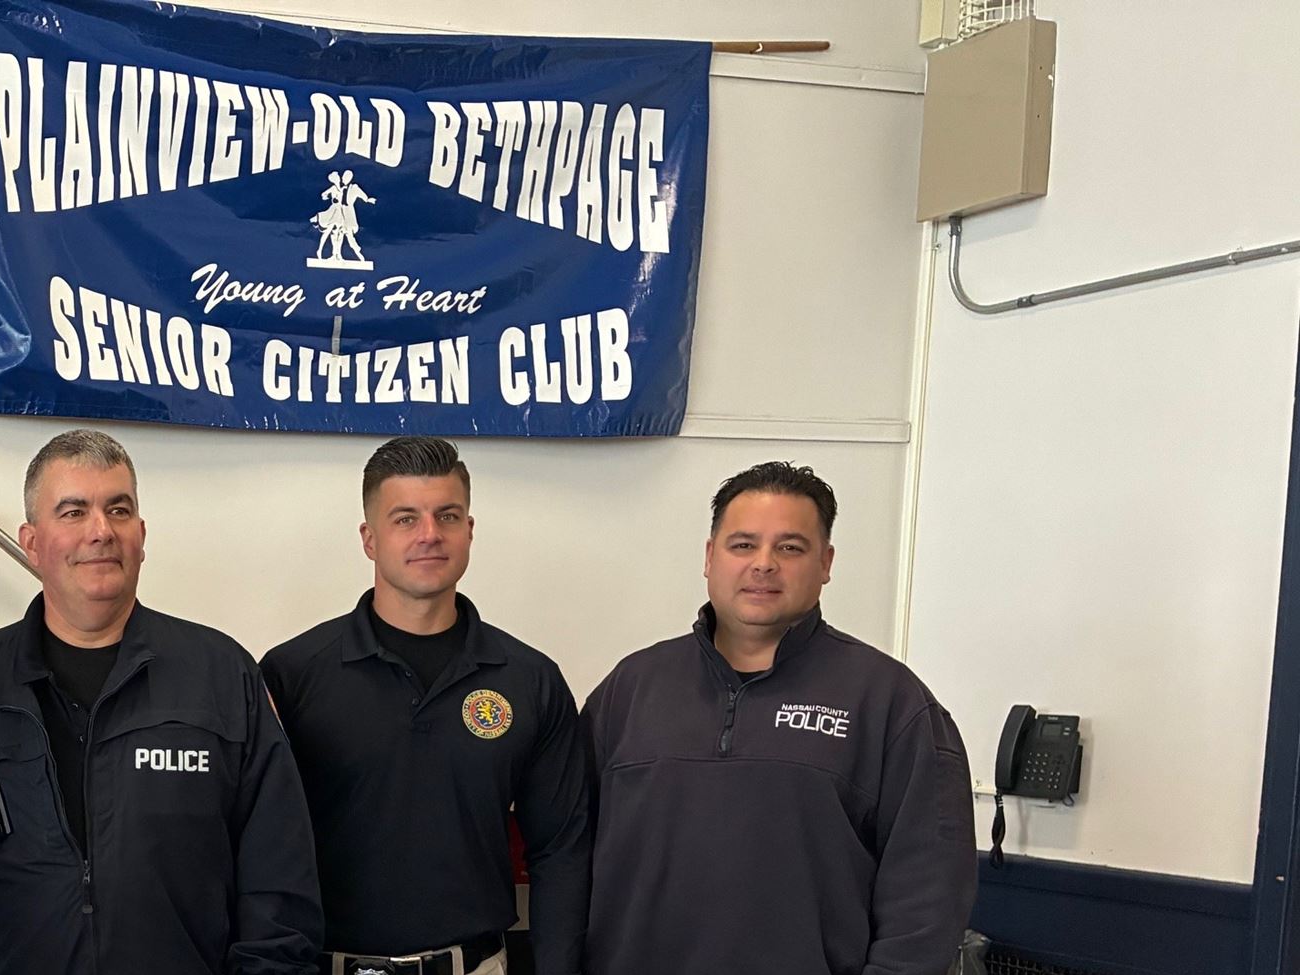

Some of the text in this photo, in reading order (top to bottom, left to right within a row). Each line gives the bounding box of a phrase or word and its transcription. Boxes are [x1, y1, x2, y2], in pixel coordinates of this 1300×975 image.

[426, 99, 670, 253] BETHPAGE
[190, 262, 488, 315] Young at Heart
[49, 276, 633, 405] SENIOR CITIZEN CLUB
[775, 710, 850, 738] POLICE
[781, 703, 849, 718] NASSAU COUNTY
[135, 748, 210, 772] POLICE
